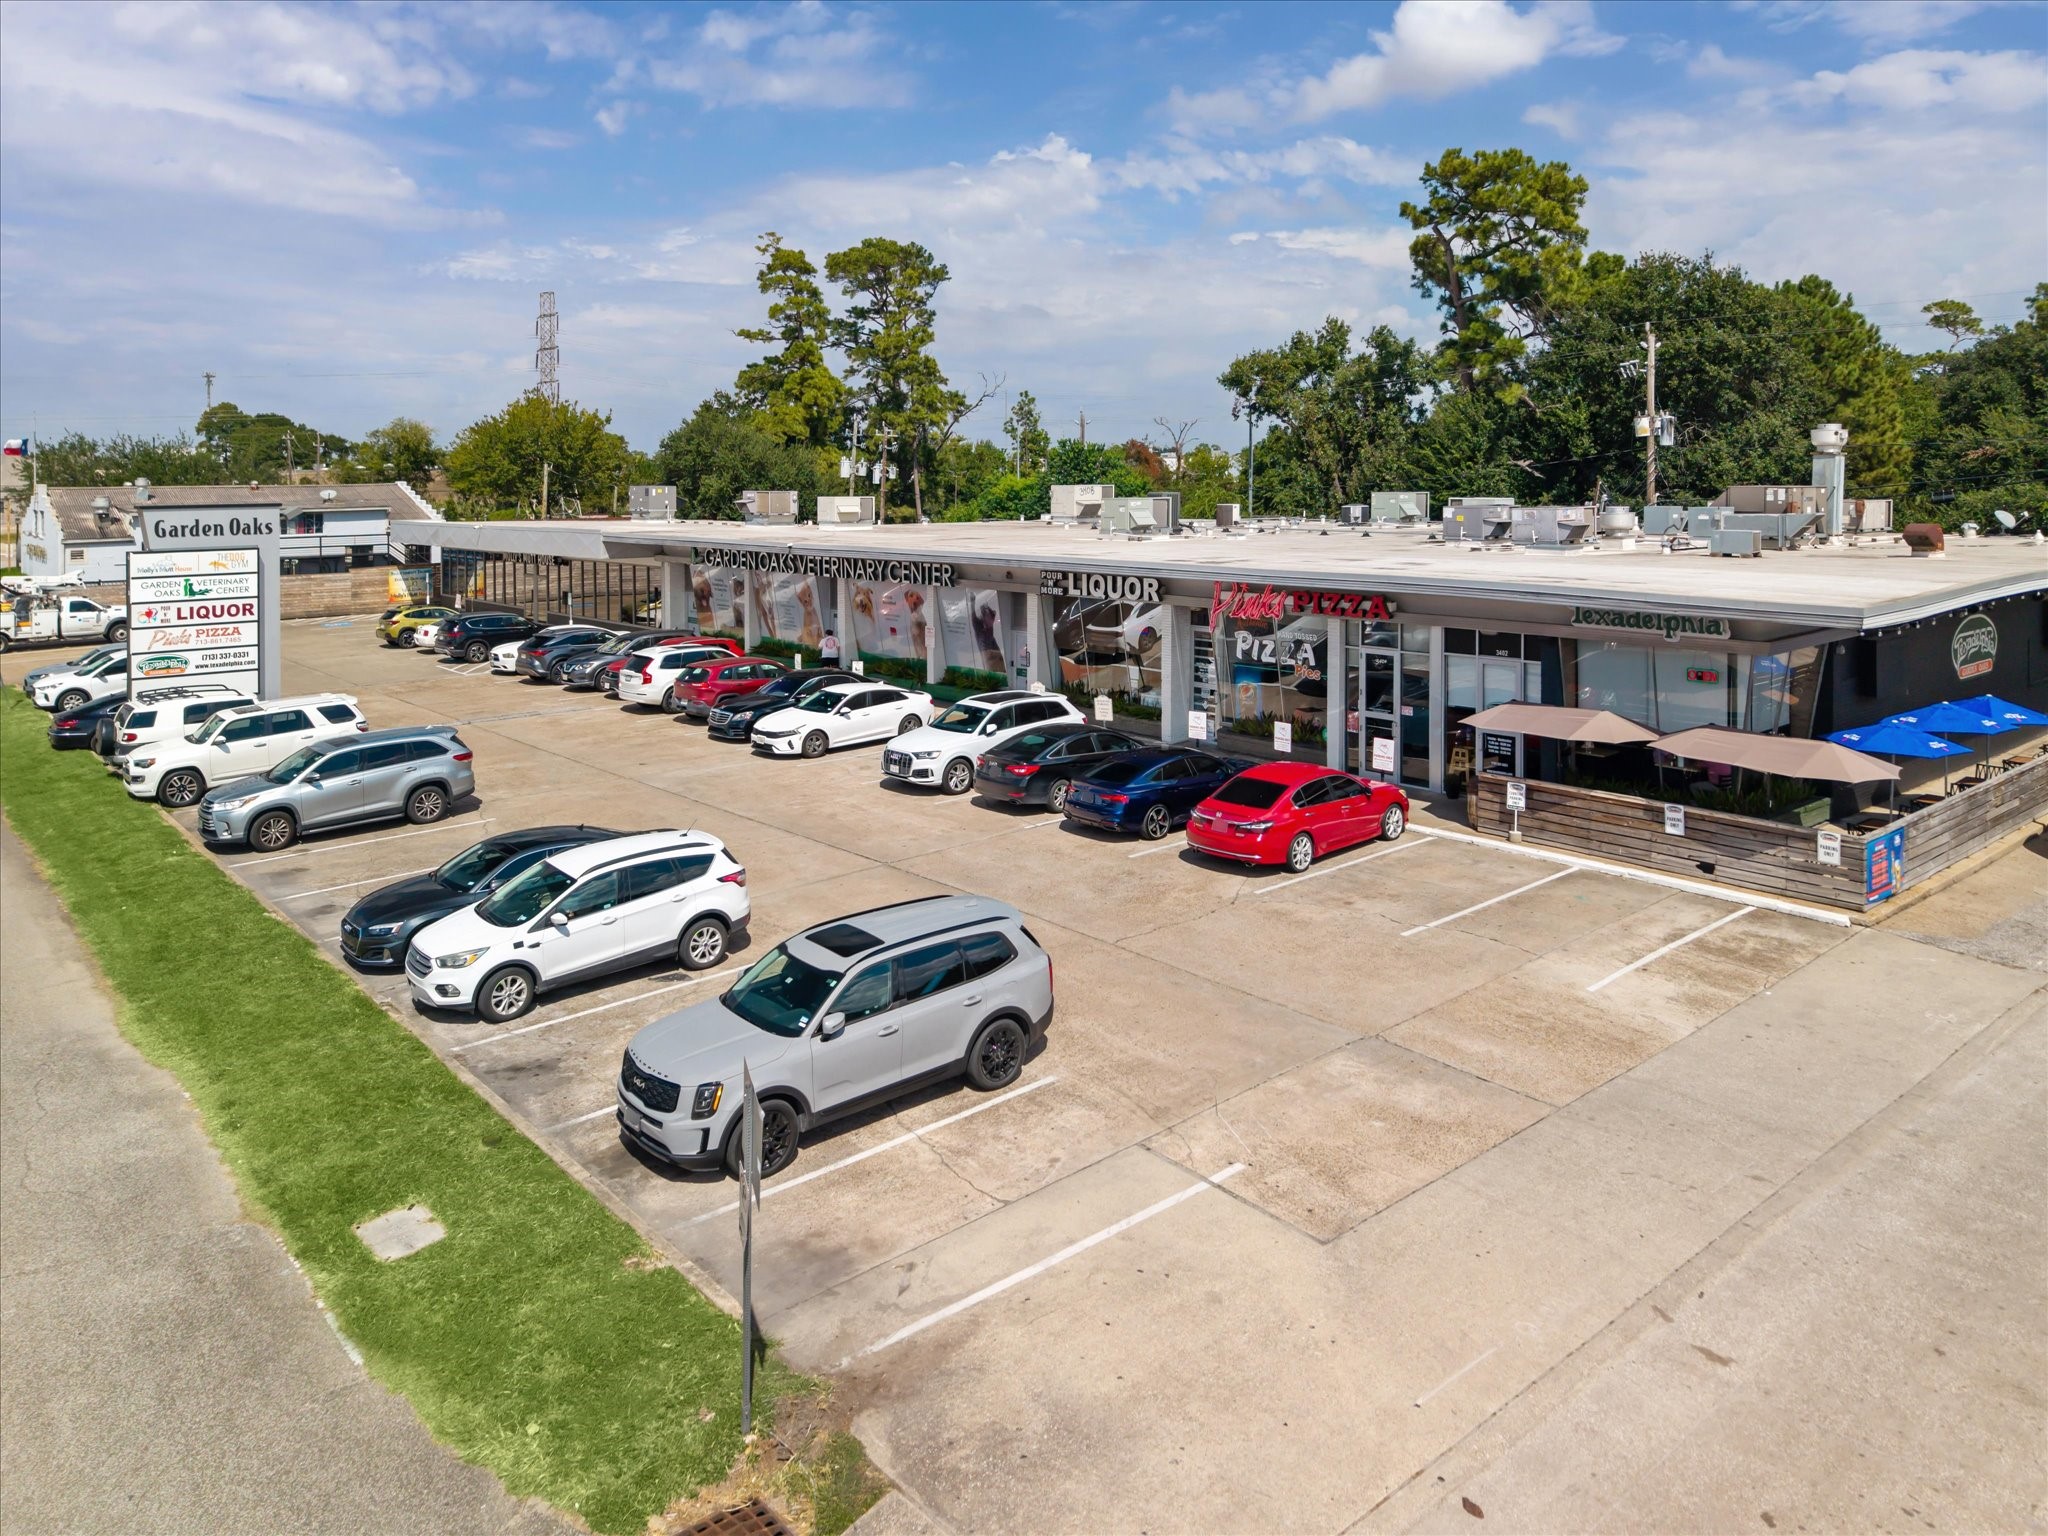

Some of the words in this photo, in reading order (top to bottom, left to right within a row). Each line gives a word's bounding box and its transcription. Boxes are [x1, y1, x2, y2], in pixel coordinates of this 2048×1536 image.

[154, 519, 224, 538] Garden
[229, 517, 273, 535] Oaks
[704, 548, 755, 571] GARDEN
[758, 552, 794, 575] OAKS
[797, 555, 885, 581] VETERINARY
[887, 561, 952, 587] CENTER
[1041, 571, 1062, 580] POUR
[140, 581, 181, 590] GARDEN
[196, 577, 249, 587] VETERINARY
[1068, 572, 1160, 602] LIQUOR
[154, 589, 180, 598] OAKS
[215, 586, 249, 594] CENTER
[1041, 587, 1063, 596] MORE
[1292, 591, 1391, 620] PIZZA
[176, 603, 255, 620] LIQUOR
[195, 626, 241, 638] PIZZA
[1294, 632, 1317, 641] TOSSED
[1234, 630, 1316, 666] PIZZA
[202, 653, 218, 661] (713)
[219, 651, 249, 660] 337-0331
[195, 660, 256, 669] www.texadelphia.com
[1295, 664, 1321, 680] Pies
[1820, 844, 1838, 852] PARKING
